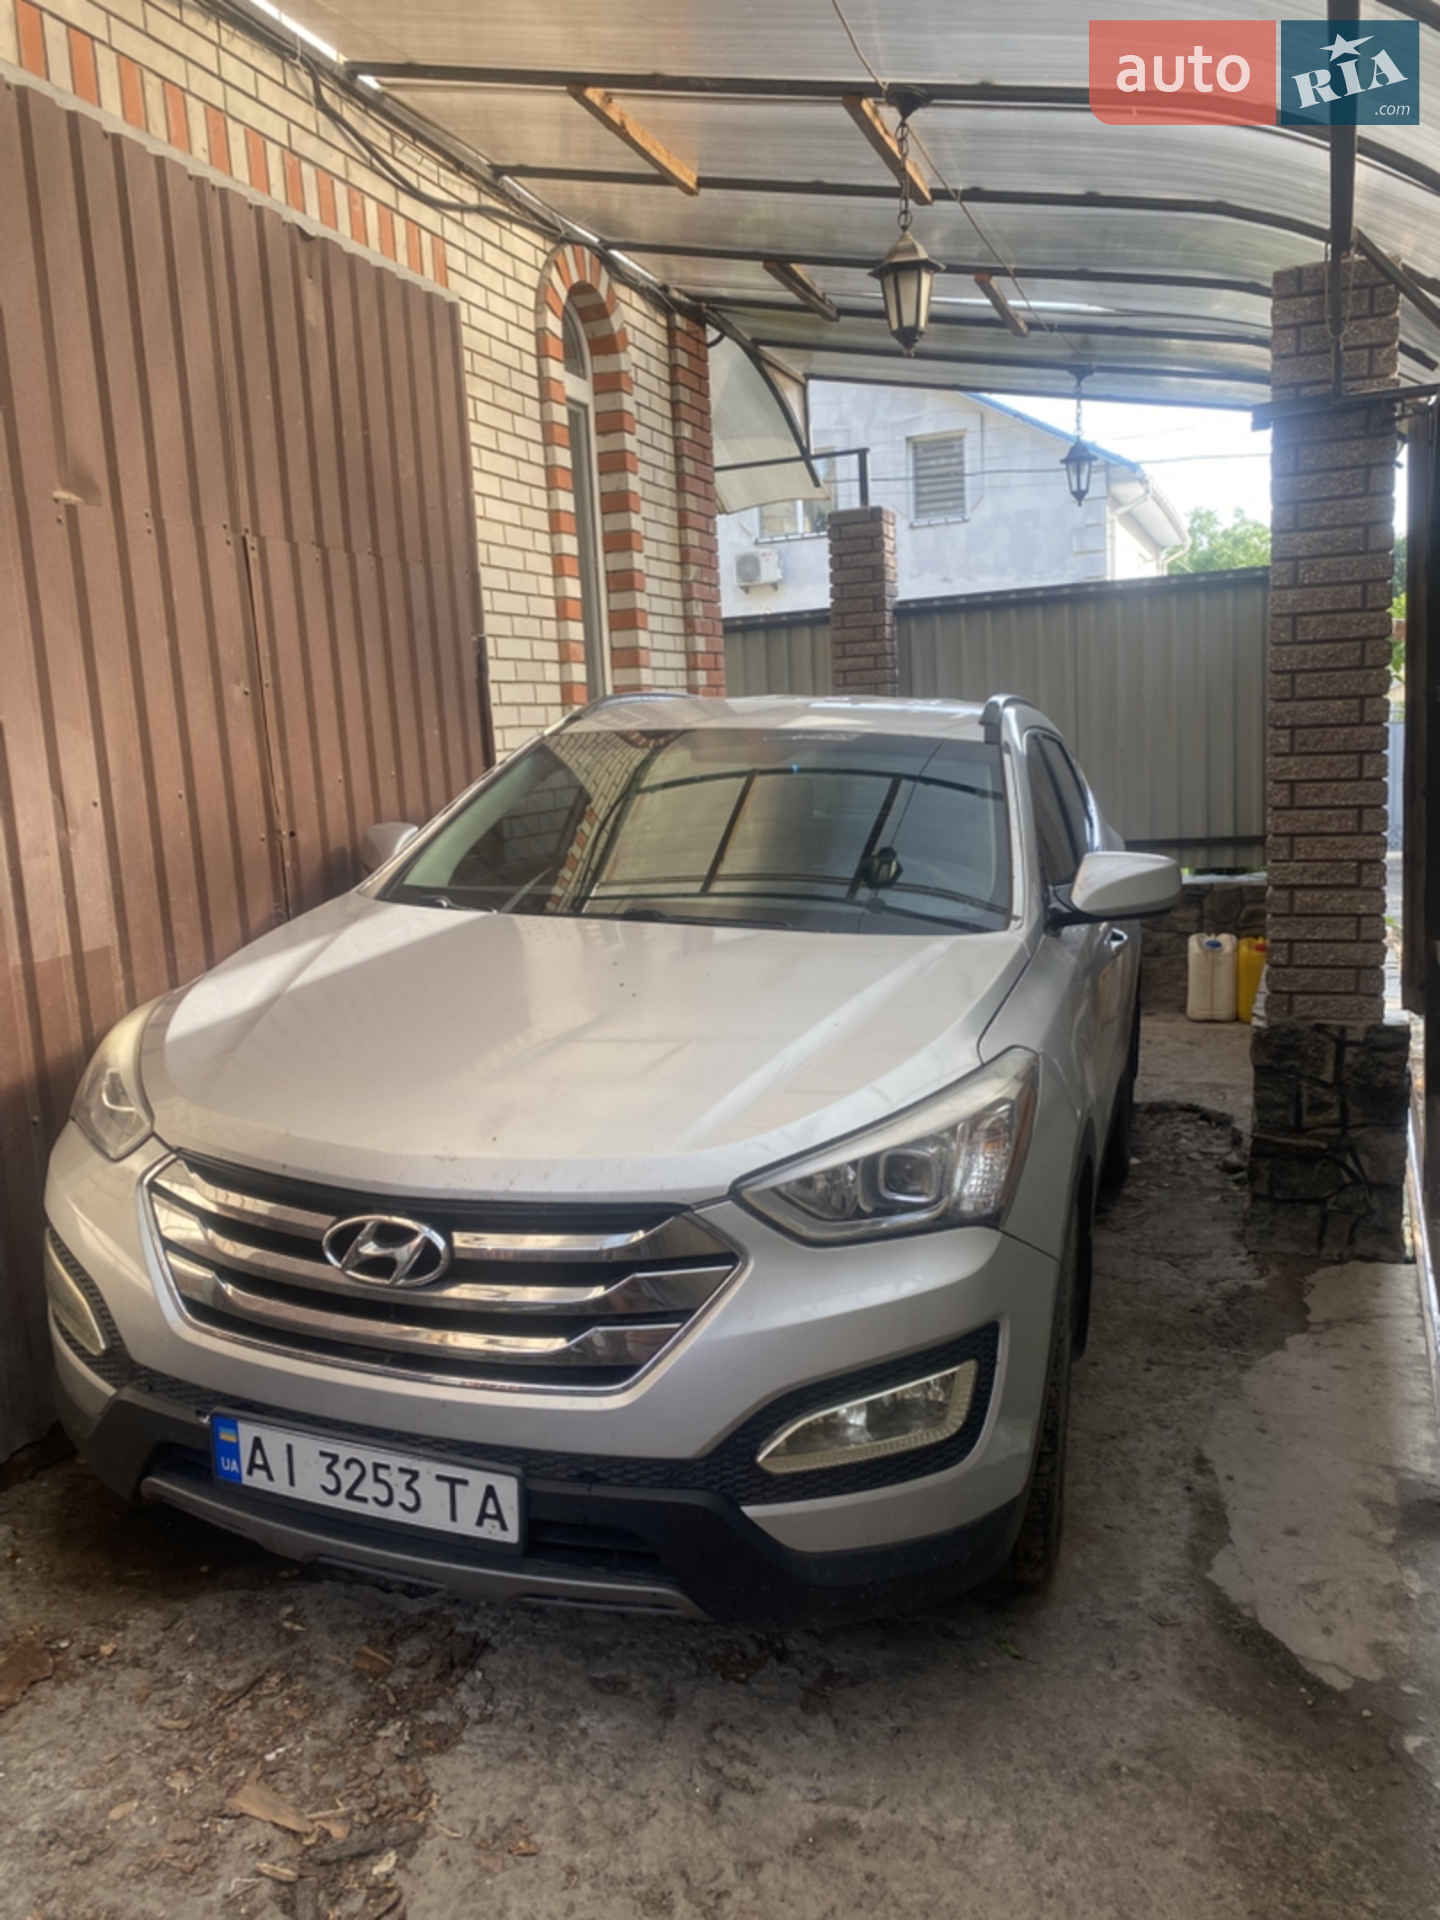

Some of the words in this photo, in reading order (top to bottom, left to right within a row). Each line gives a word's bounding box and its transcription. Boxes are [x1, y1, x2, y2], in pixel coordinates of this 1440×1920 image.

[221, 1456, 240, 1473] UA
[318, 1450, 421, 1513] 3253
[434, 1474, 509, 1532] TA
